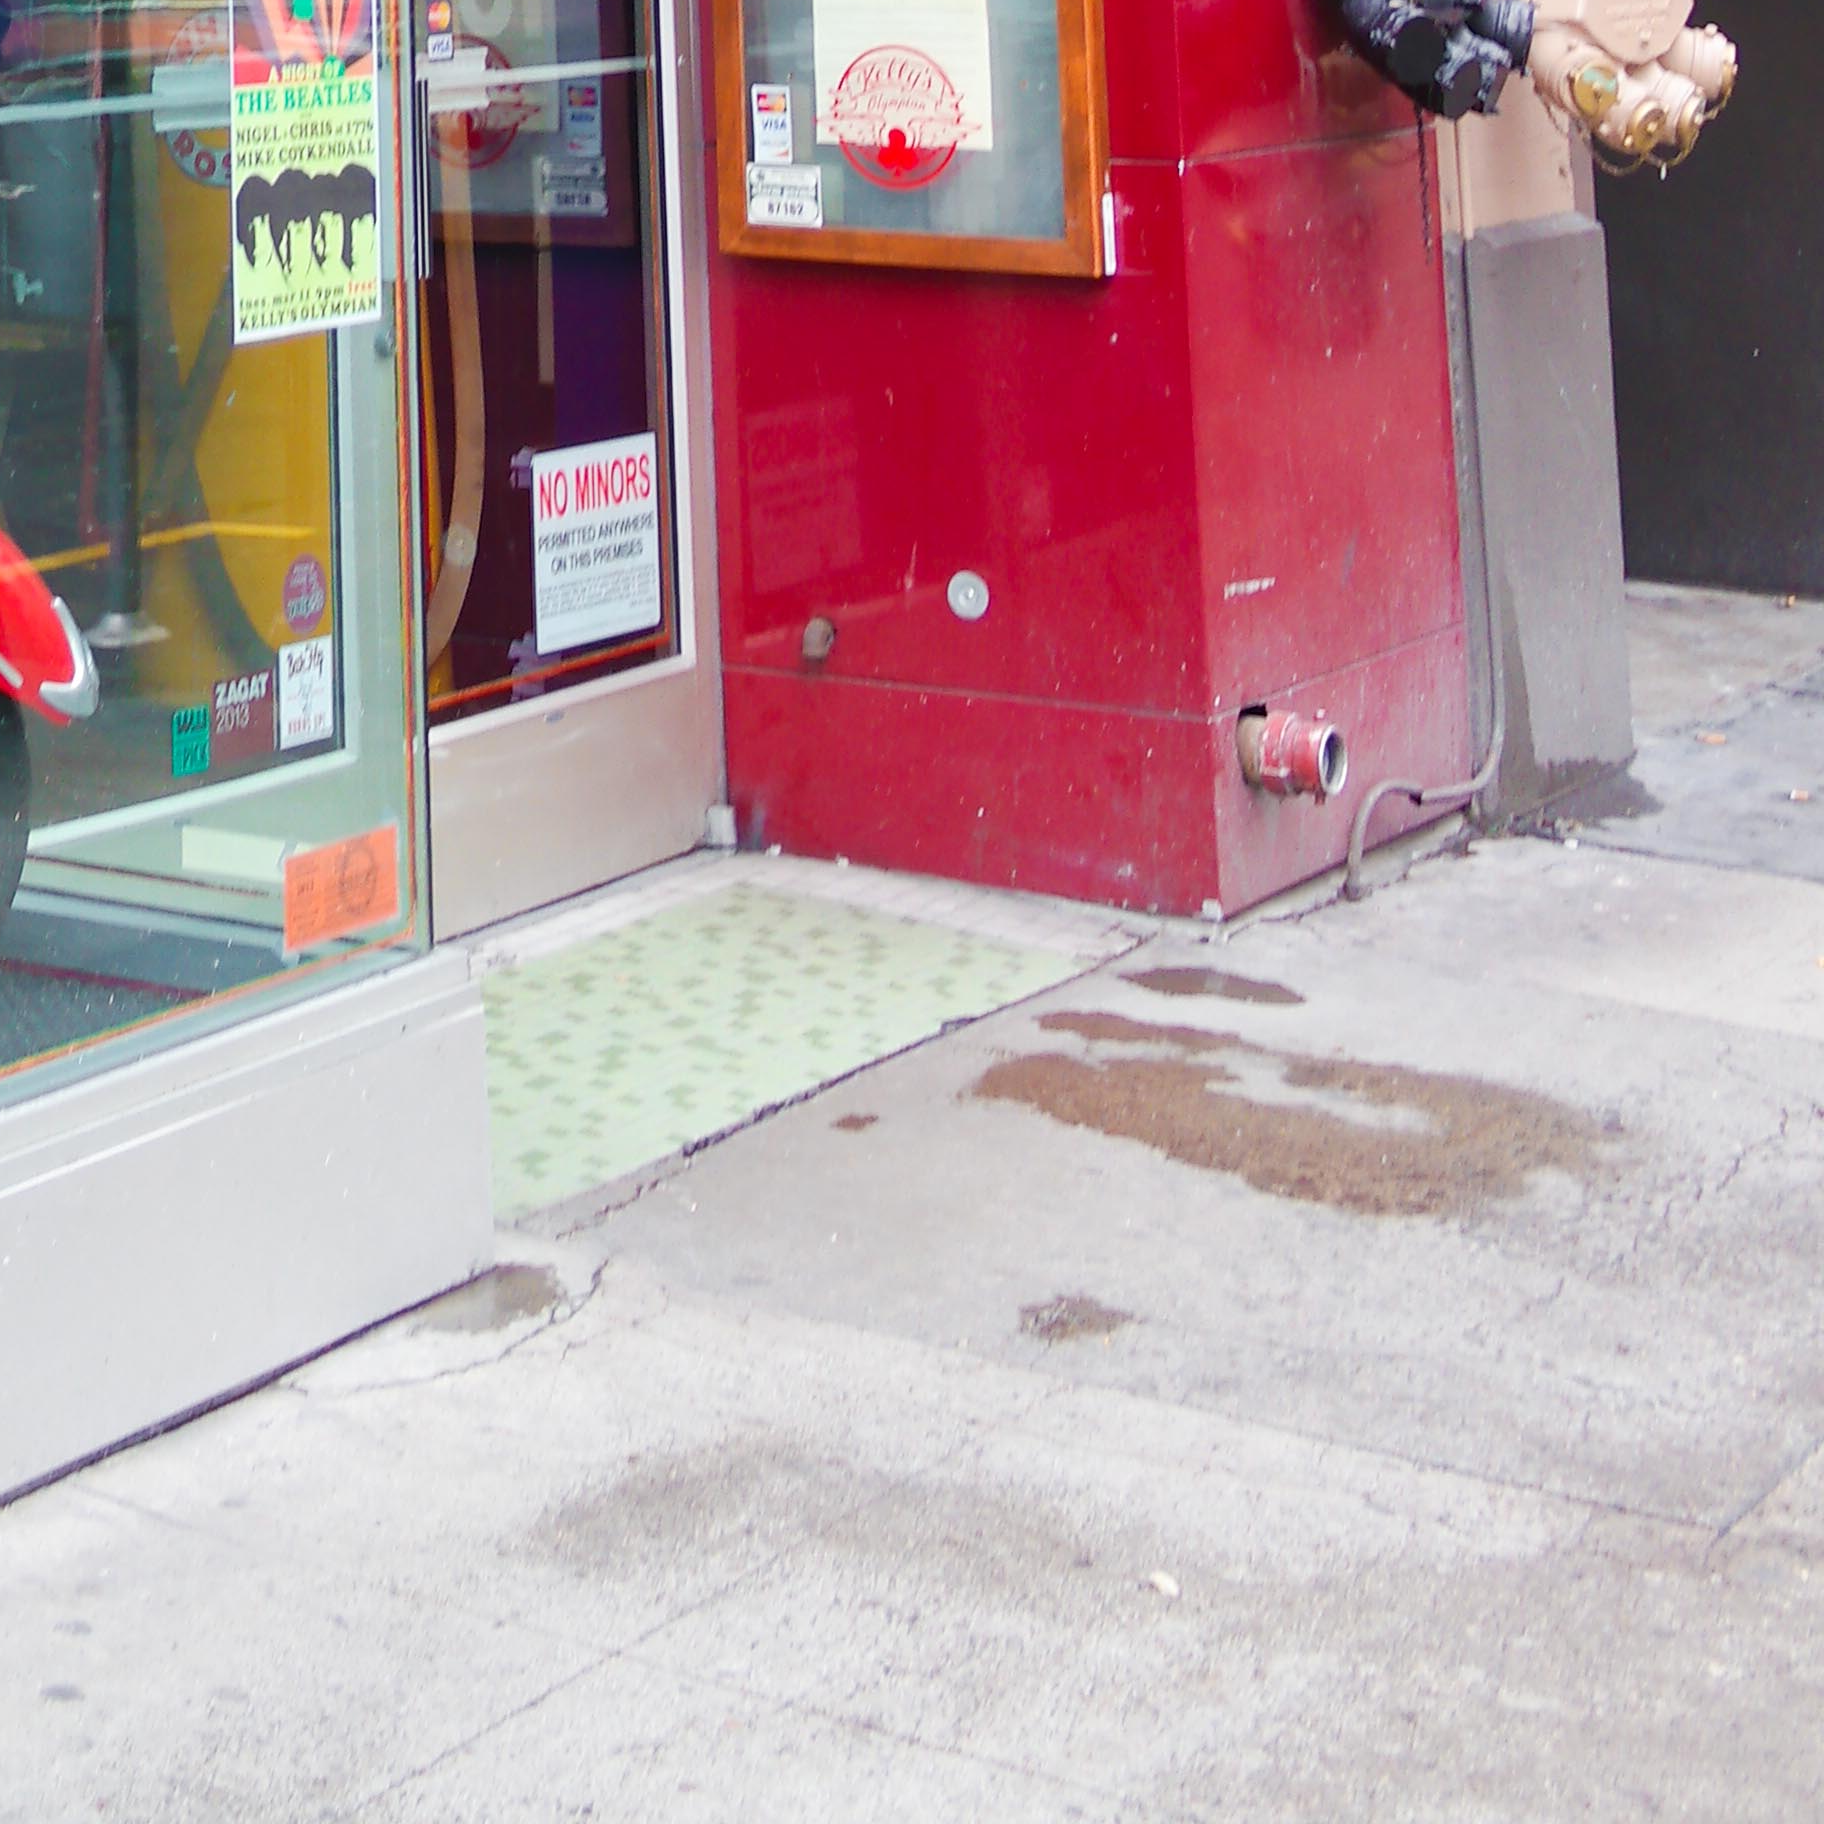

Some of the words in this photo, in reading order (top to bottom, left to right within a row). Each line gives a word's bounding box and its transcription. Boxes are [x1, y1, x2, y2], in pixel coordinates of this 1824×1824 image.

[236, 87, 278, 115] THE
[283, 80, 373, 112] BEATLES
[236, 124, 282, 147] NIGEL
[289, 119, 333, 140] CHRIS
[762, 118, 788, 130] VISA
[236, 146, 276, 169] MIKE
[278, 139, 375, 164] COYKENDALL
[239, 310, 297, 333] KELLY'S
[300, 297, 377, 322] OLYMPIAN
[539, 469, 569, 521] NO
[574, 453, 651, 514] MINORS
[538, 526, 596, 552] PERMITTED
[598, 510, 655, 543] ANYWHERE
[550, 556, 567, 577] ON
[570, 551, 592, 572] THIS
[593, 537, 644, 569] PREMISES
[215, 671, 270, 710] ZAGAT
[216, 702, 250, 735] 2013
